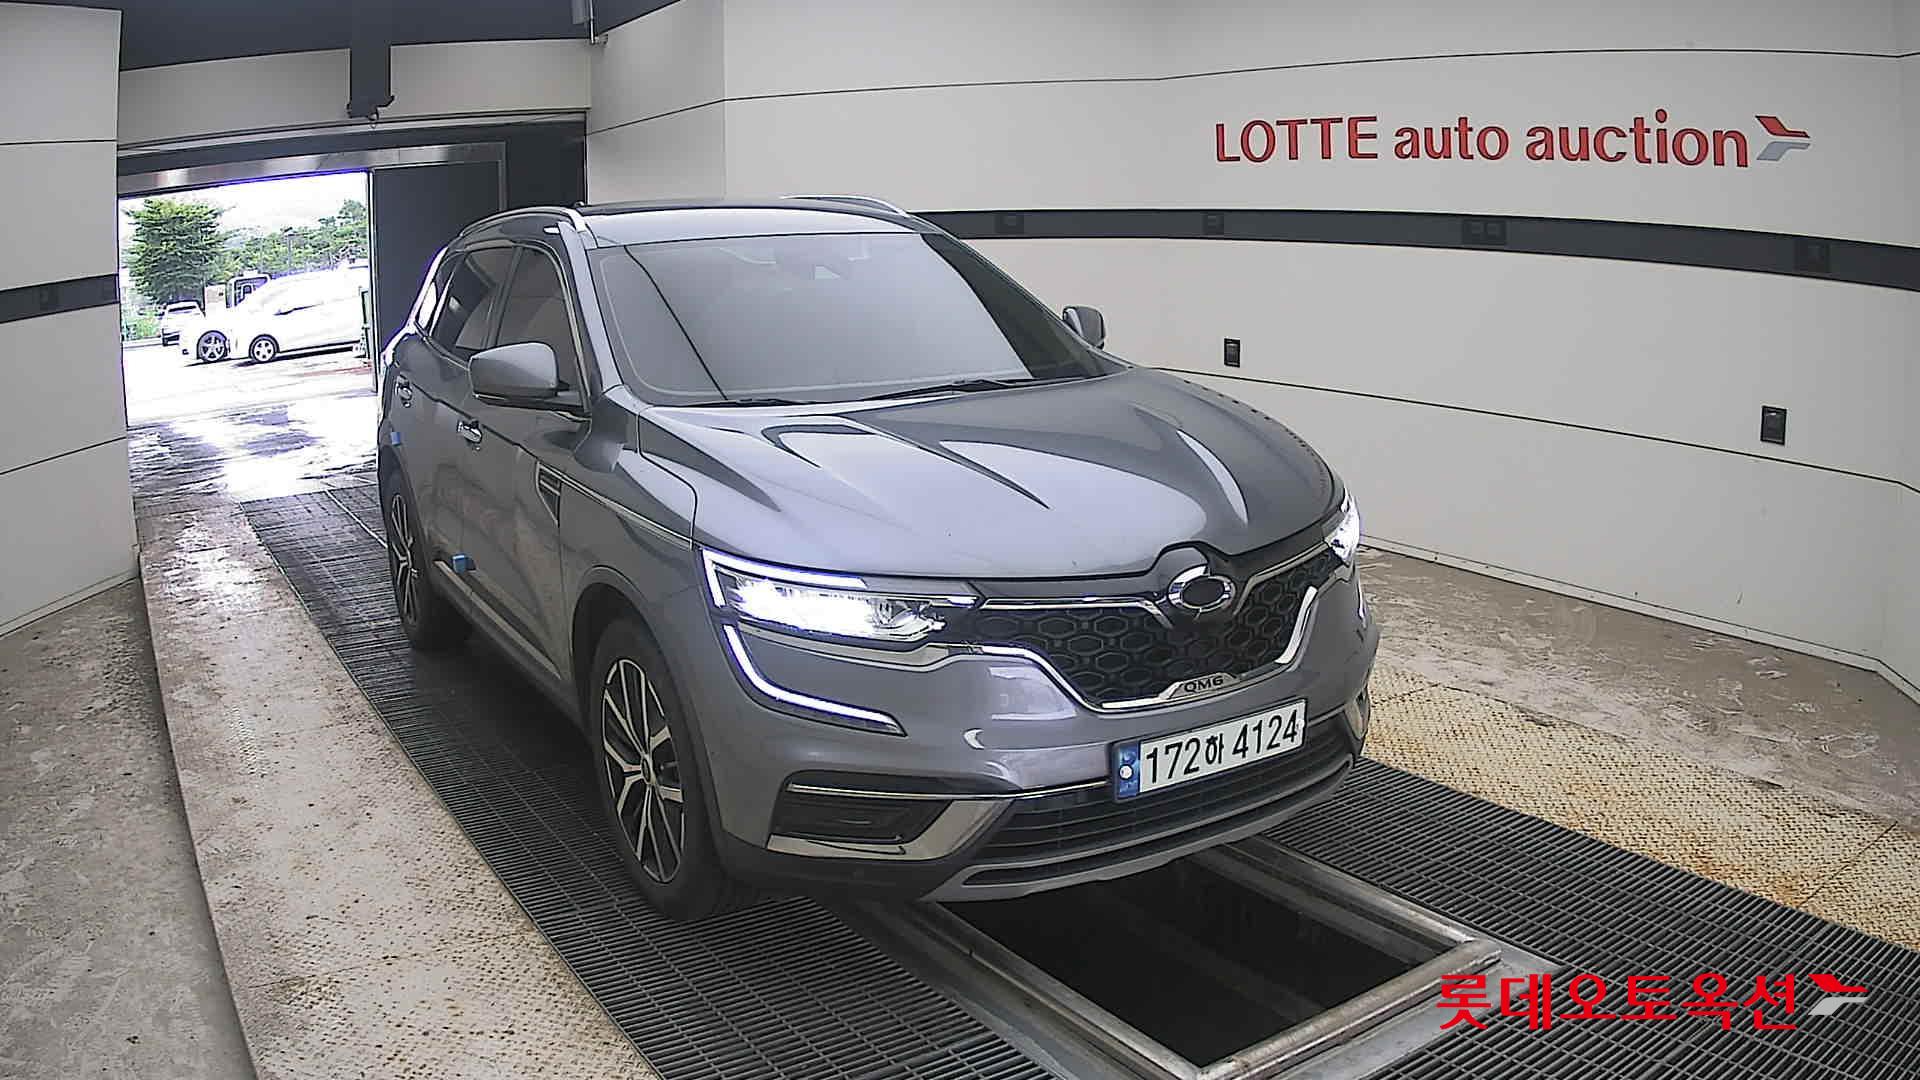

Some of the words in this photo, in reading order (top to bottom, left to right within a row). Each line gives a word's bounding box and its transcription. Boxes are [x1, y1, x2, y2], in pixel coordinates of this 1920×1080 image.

[1215, 115, 1378, 163] LOTTE
[1394, 116, 1510, 161] auto
[1525, 109, 1749, 168] auction
[1184, 676, 1224, 693] QM6
[1146, 732, 1225, 784] 172하
[1232, 709, 1298, 759] 4124
